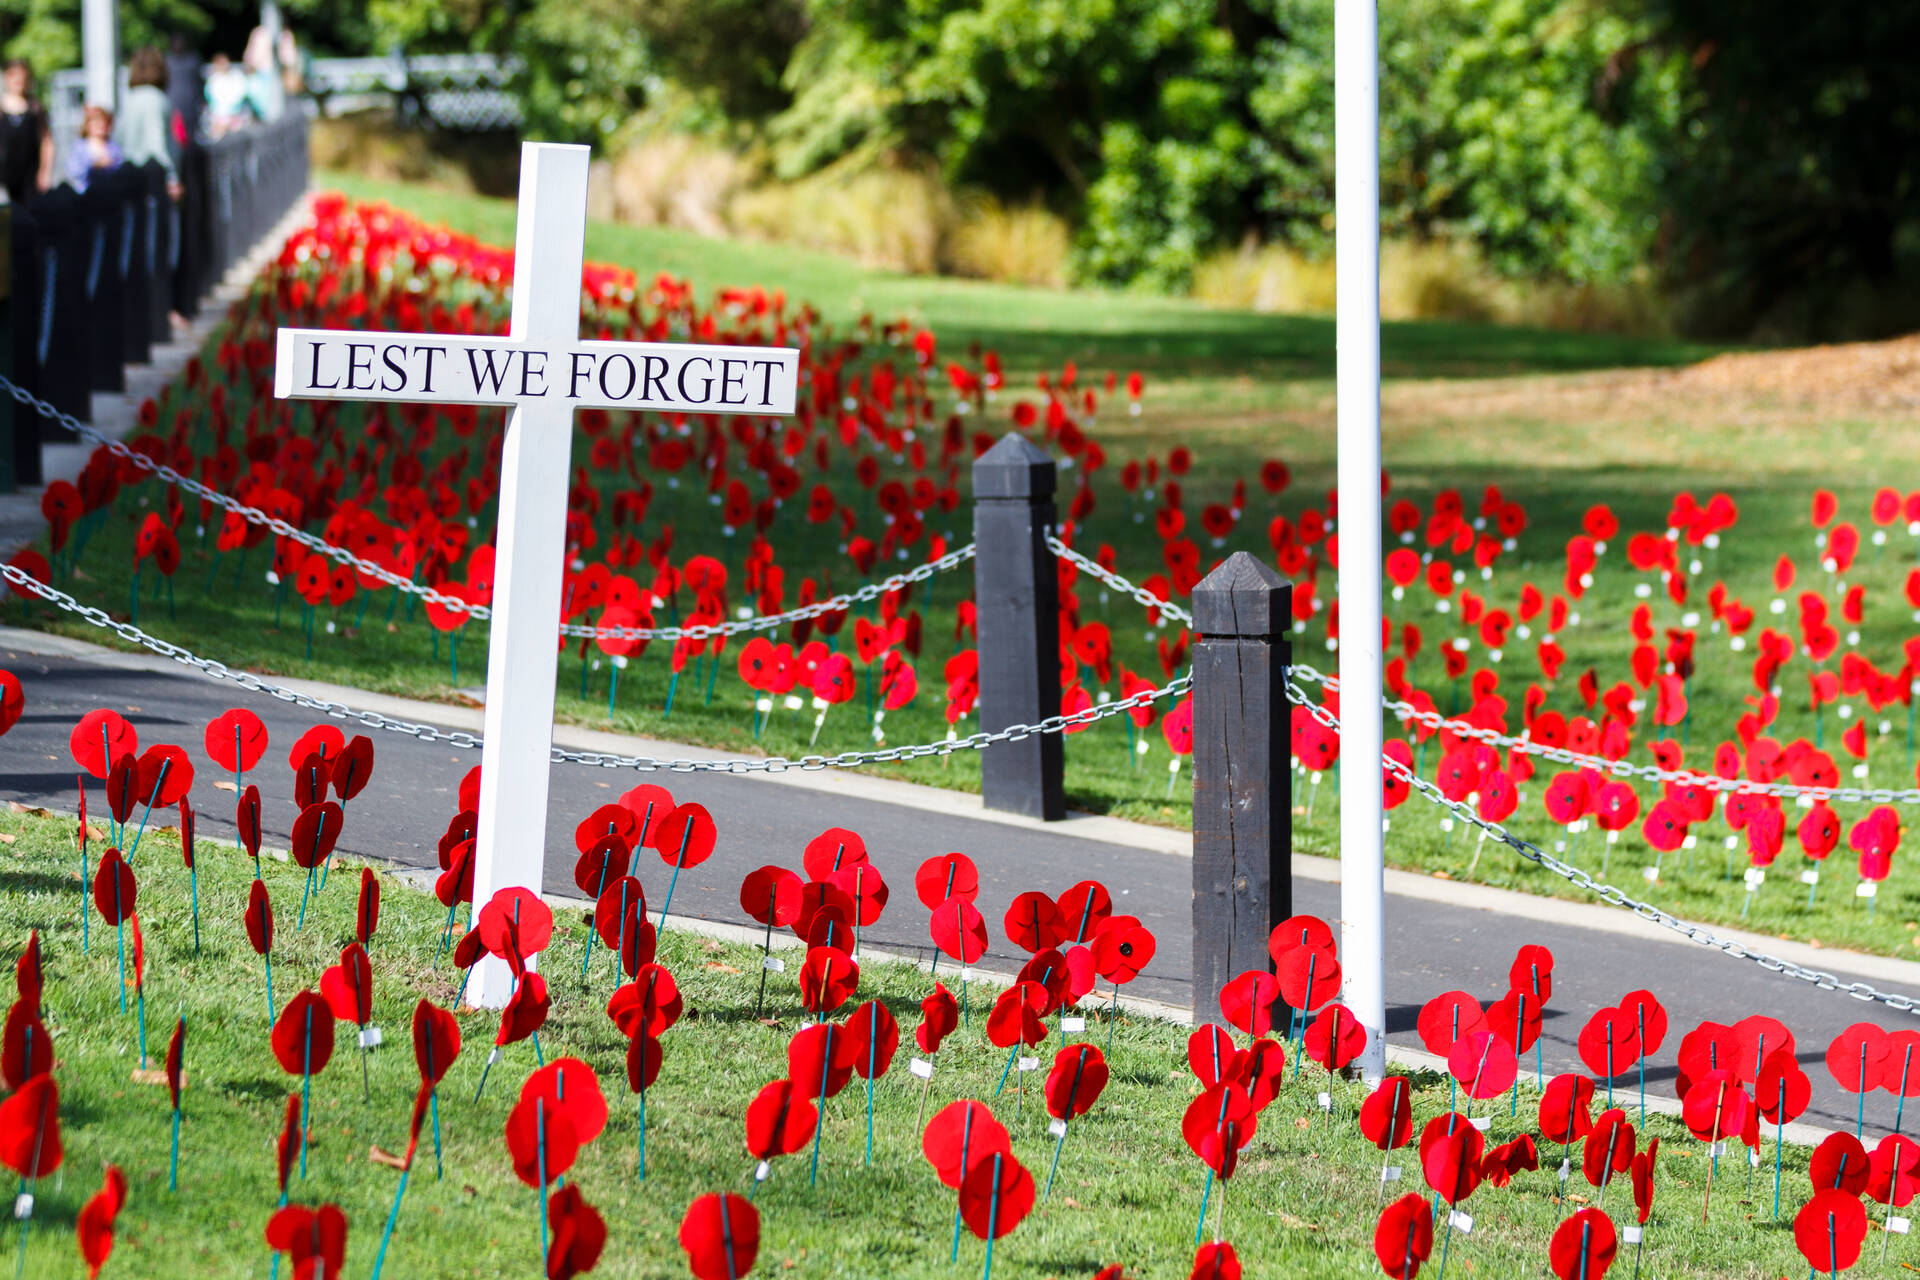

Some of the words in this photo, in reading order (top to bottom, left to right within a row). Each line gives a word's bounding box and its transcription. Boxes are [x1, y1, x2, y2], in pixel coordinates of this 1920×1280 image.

[306, 342, 447, 393] LEST
[463, 348, 550, 397] WE
[565, 352, 786, 406] FORGET
